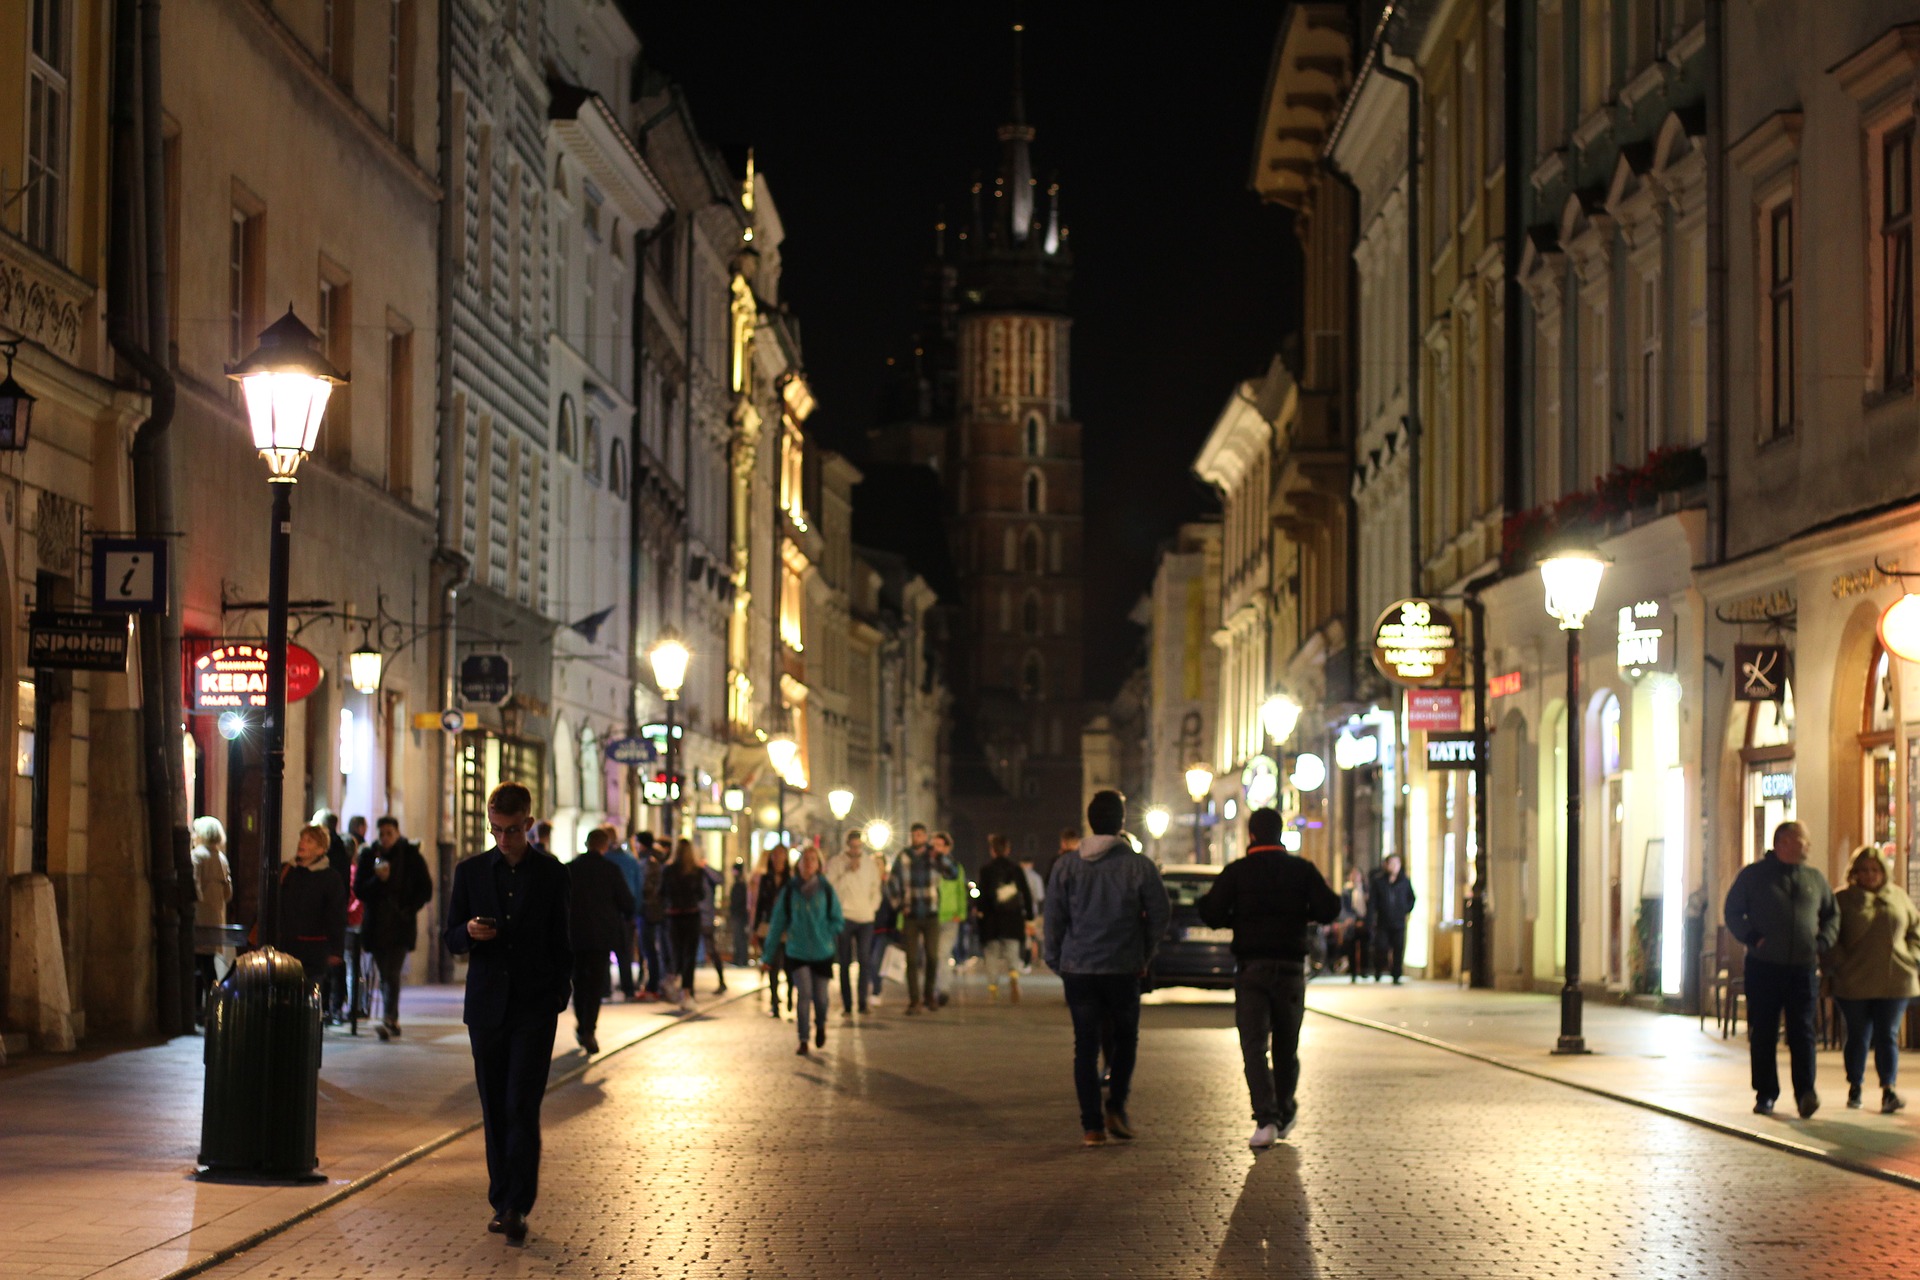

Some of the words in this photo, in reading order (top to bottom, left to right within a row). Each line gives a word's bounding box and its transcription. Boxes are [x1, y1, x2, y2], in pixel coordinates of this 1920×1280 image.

[1401, 602, 1430, 625] 36
[195, 645, 268, 670] BEIRU
[201, 673, 268, 692] KEBA
